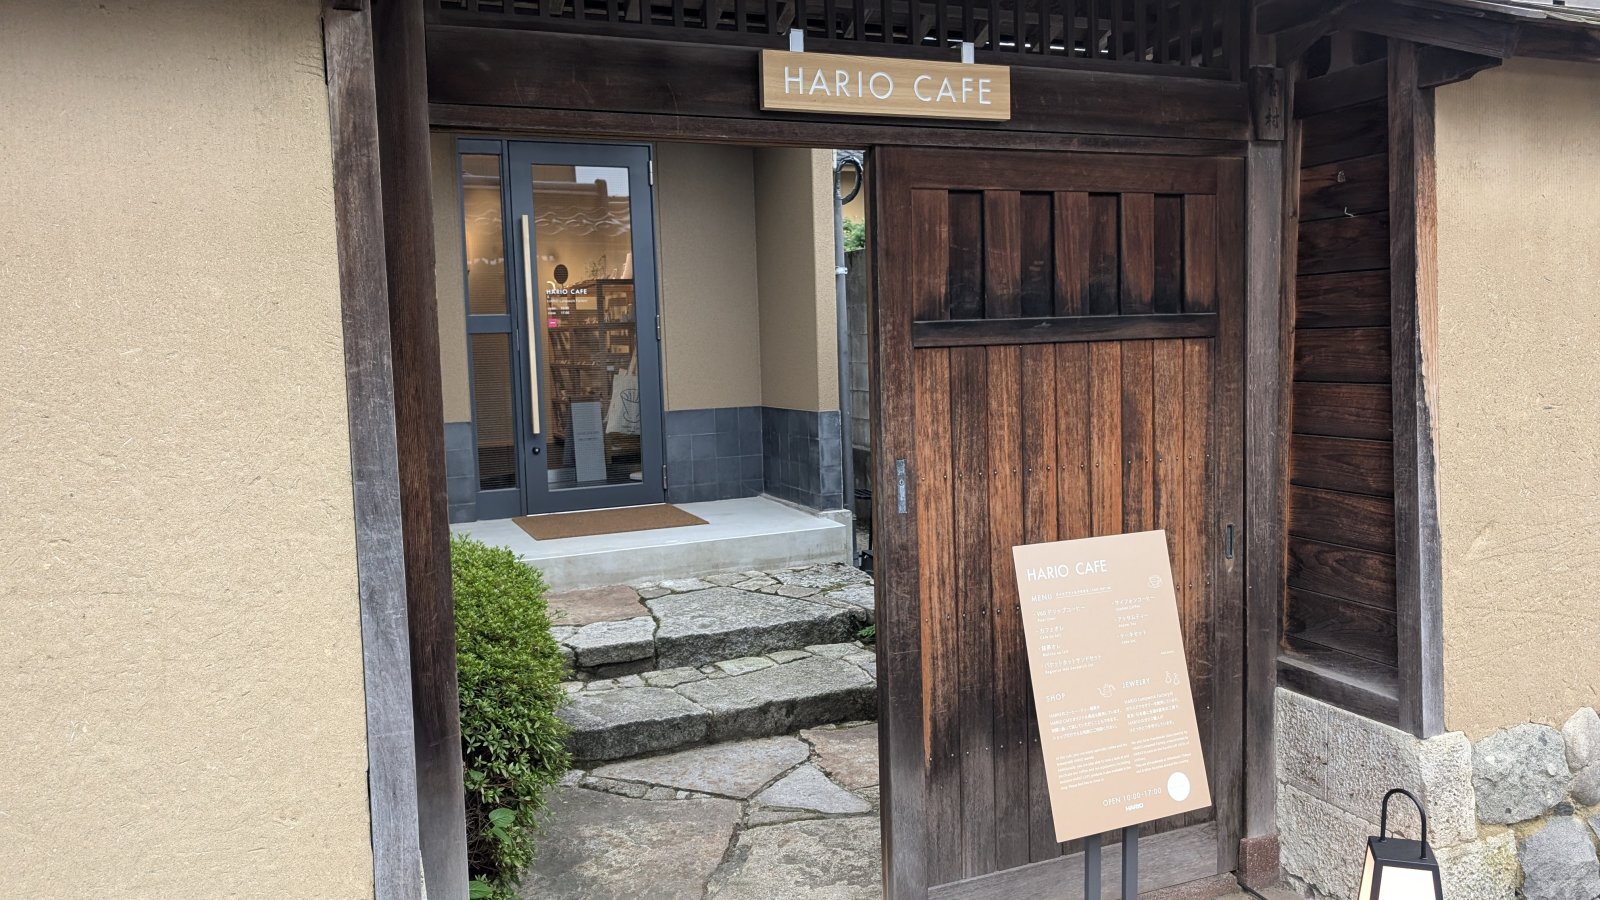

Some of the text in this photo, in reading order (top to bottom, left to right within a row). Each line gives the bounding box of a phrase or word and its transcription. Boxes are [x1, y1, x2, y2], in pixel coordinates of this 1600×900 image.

[783, 66, 992, 105] HARIO CAFE
[1027, 559, 1108, 581] HARIO CAFE
[1031, 593, 1053, 602] MENU
[1122, 678, 1150, 688] JEWELRY
[1046, 693, 1066, 702] SHOP
[1103, 797, 1121, 806] OPEN
